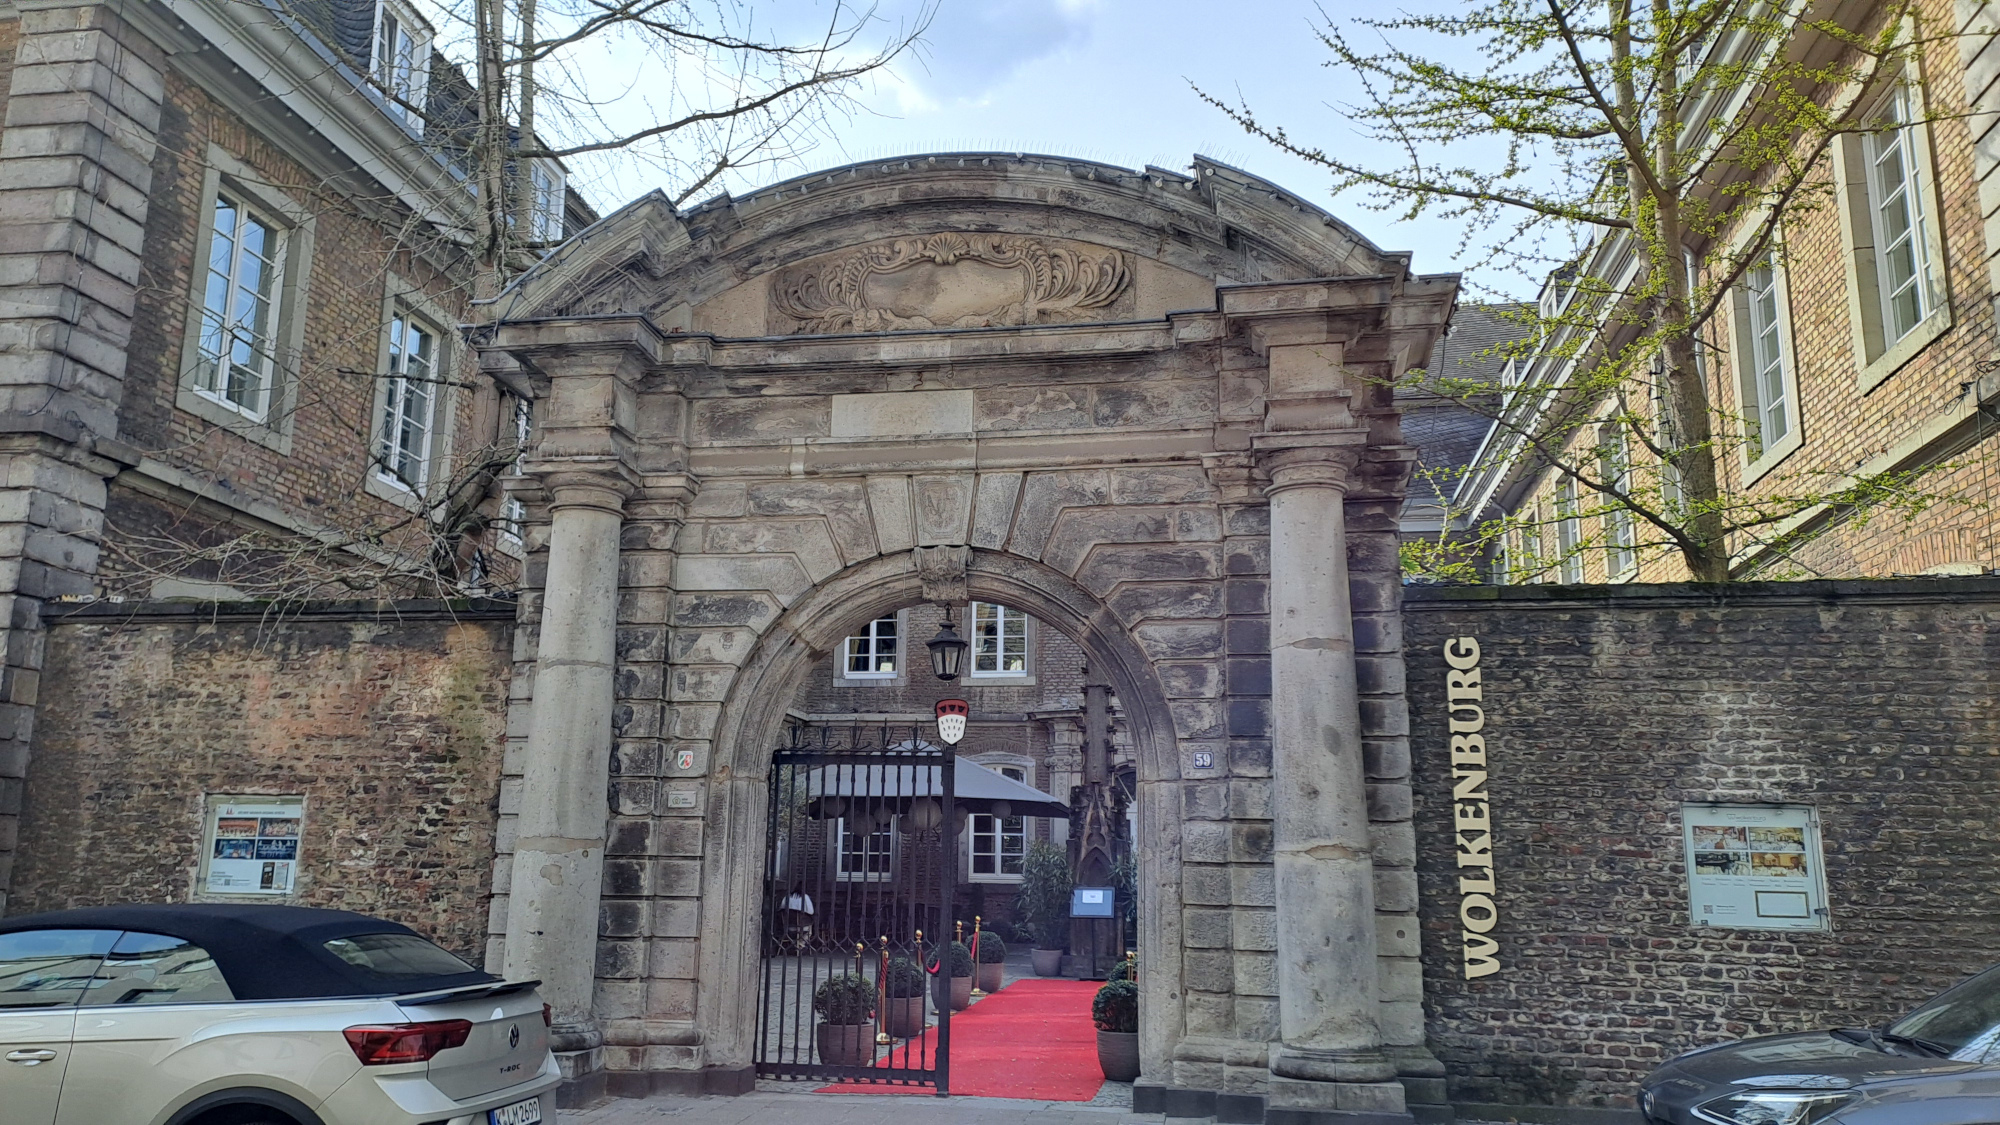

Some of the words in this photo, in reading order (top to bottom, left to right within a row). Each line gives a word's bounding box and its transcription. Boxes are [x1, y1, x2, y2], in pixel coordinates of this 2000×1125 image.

[1195, 753, 1211, 767] 59
[1444, 637, 1500, 980] WOLKENBURG
[499, 1063, 521, 1074] T-ROC
